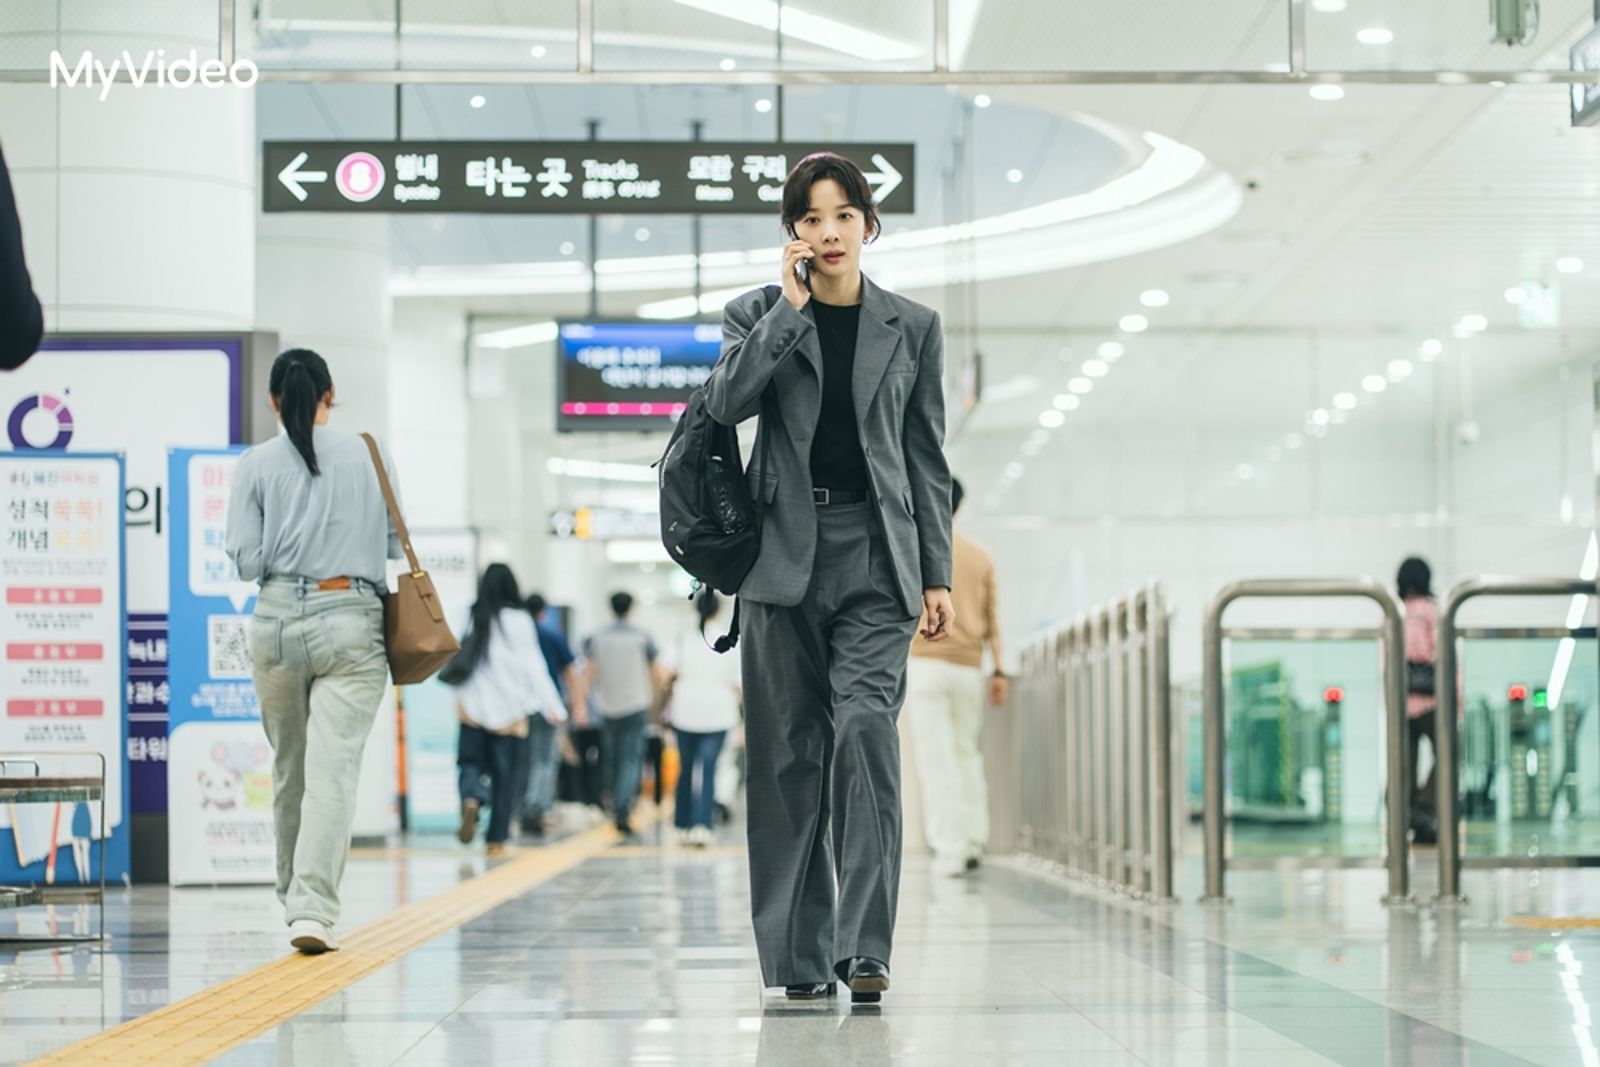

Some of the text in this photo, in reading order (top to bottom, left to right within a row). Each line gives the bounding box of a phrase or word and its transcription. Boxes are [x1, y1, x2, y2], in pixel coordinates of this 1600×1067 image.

[465, 156, 532, 197] 타는
[536, 158, 573, 197] 곳
[581, 159, 639, 180] Tracks
[687, 155, 786, 182] 모란 구리
[8, 529, 49, 552] 개념
